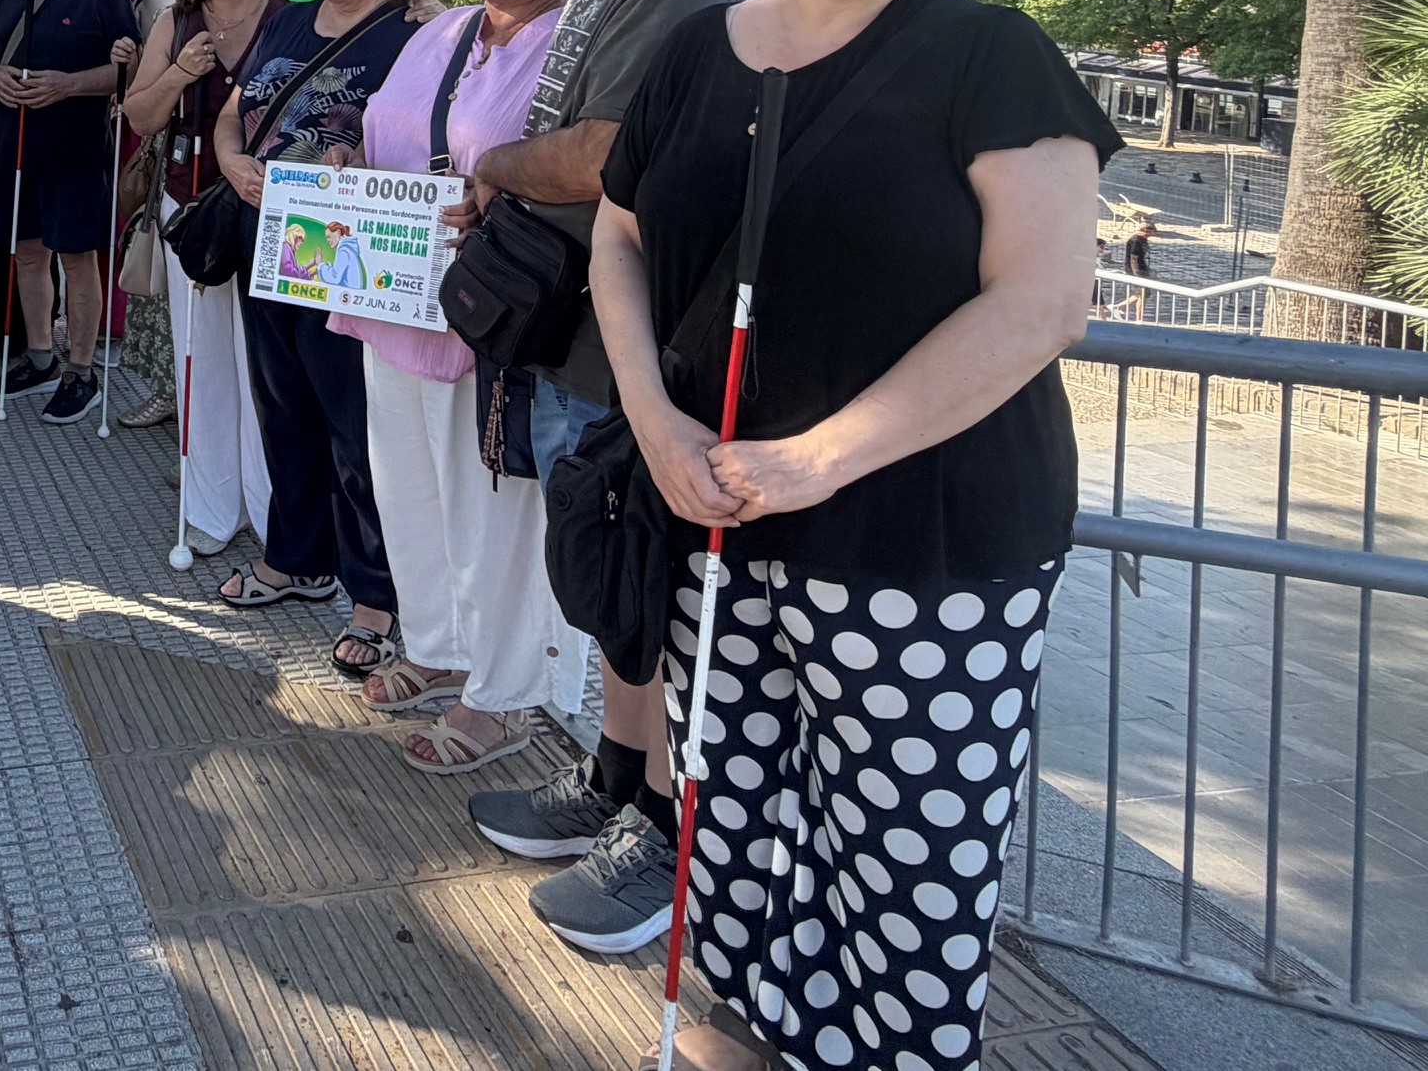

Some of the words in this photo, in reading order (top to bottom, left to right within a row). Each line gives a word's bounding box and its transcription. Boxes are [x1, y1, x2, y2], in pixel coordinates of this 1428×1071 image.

[337, 86, 368, 104] the
[338, 173, 359, 186] 000
[365, 176, 438, 205] 00000
[447, 184, 458, 195] 2€
[338, 187, 355, 196] SERIE
[298, 198, 333, 209] Internacional
[334, 202, 342, 210] de
[342, 203, 351, 211] las
[351, 205, 378, 215] Personas
[390, 209, 432, 221] Sordoceguera
[356, 219, 375, 234] LAS
[375, 220, 410, 239] MANOS
[410, 226, 431, 242] QUE
[369, 236, 389, 252] NOS
[390, 238, 429, 258] HABLAN
[290, 284, 325, 299] ONCE
[394, 279, 424, 291] ONCE
[342, 293, 349, 304] S
[352, 294, 364, 306] 27
[365, 297, 387, 310] JUN.
[389, 301, 401, 313] 26
